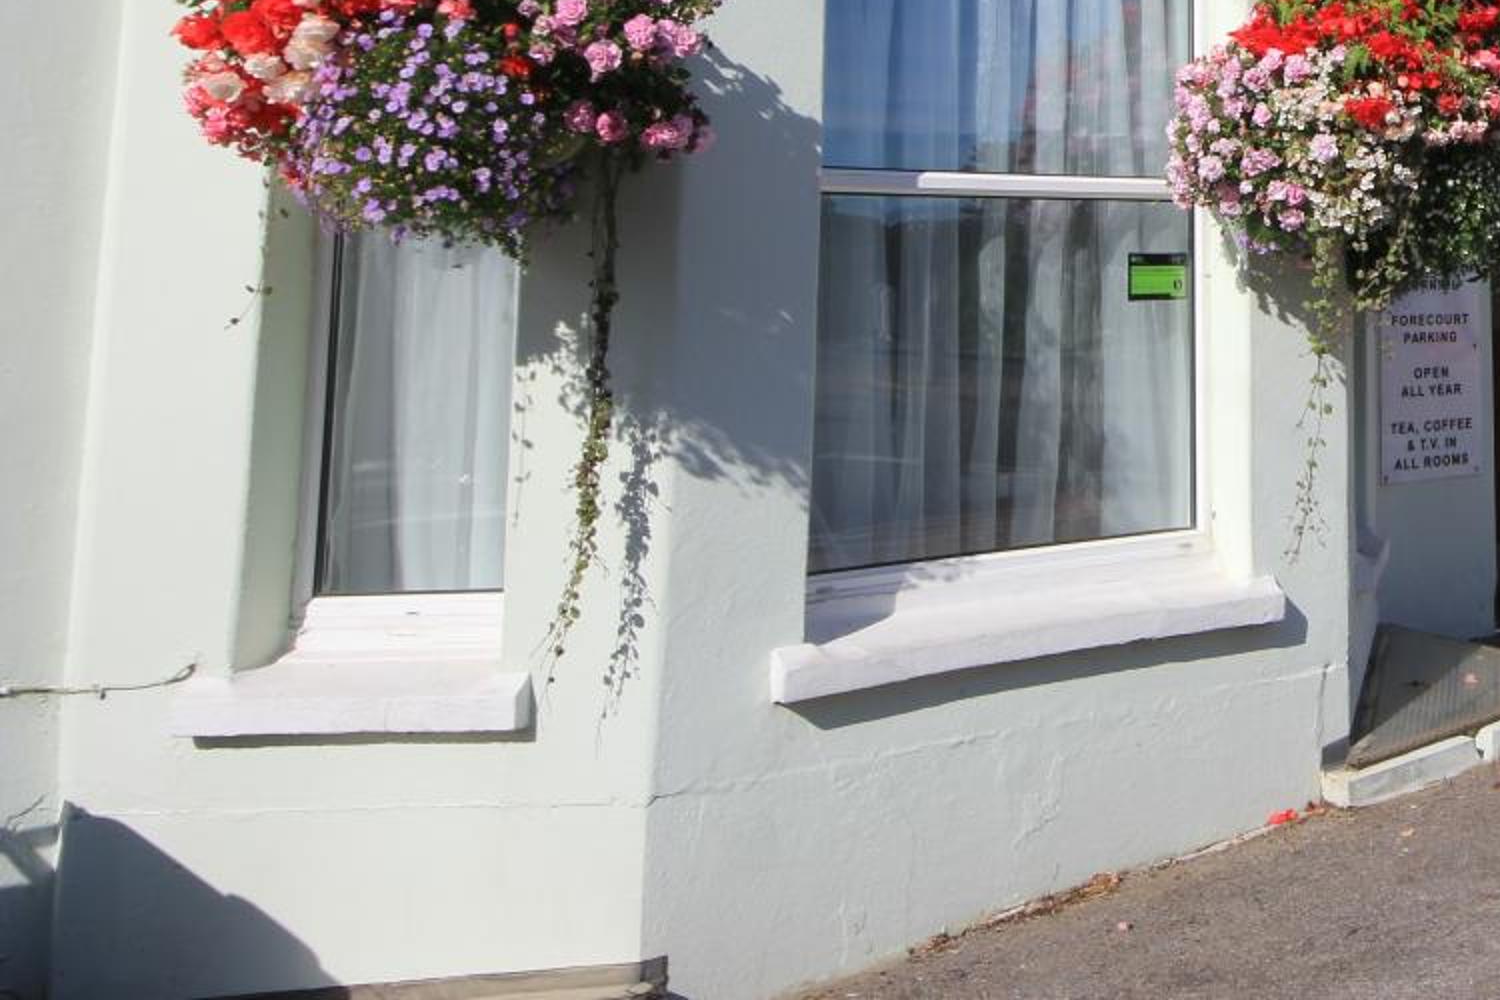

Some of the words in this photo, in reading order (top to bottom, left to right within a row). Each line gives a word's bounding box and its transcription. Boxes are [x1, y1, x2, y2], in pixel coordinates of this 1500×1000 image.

[1391, 313, 1470, 327] FORECOURT
[1403, 331, 1457, 344] PARKING
[1413, 366, 1449, 379] OPEN
[1401, 385, 1424, 398] ALL
[1428, 383, 1462, 397] YEAR
[1423, 418, 1473, 433] COFFEE
[1445, 437, 1457, 449] IN
[1394, 458, 1420, 471] ALL
[1424, 453, 1469, 468] ROOMS
